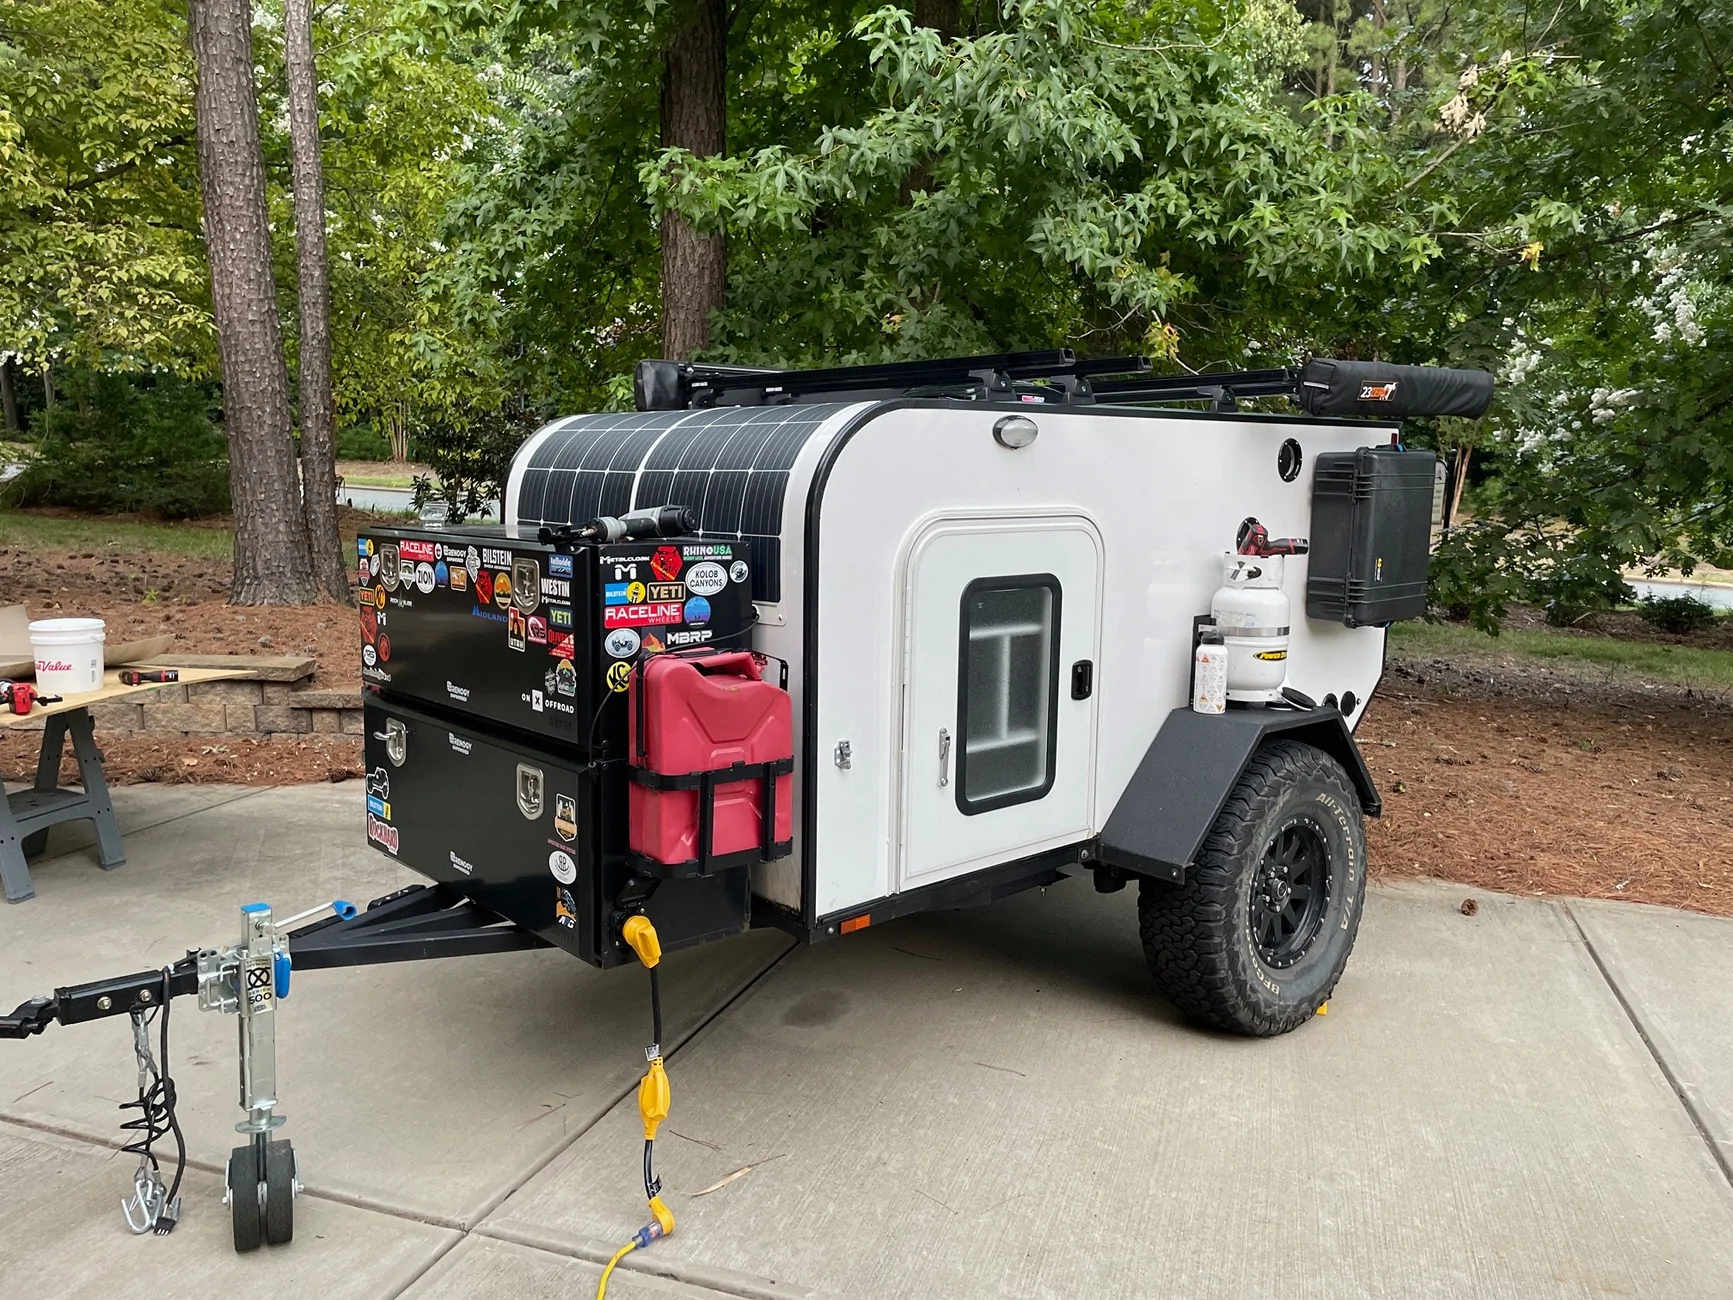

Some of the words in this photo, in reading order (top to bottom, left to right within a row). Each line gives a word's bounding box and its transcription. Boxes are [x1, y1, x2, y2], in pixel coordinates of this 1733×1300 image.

[400, 541, 433, 554] RACELINE
[683, 545, 732, 556] RHINOUSA
[483, 548, 512, 566] BILSTEIN
[418, 570, 433, 585] ZION
[696, 570, 718, 579] KOLOB
[541, 578, 570, 597] WESTIN
[690, 579, 723, 588] CANYONS
[650, 586, 682, 598] YETI
[551, 609, 571, 625] YETI
[605, 604, 680, 620] RACELINE
[648, 615, 680, 623] WHEELS
[510, 637, 524, 649] UTAH
[667, 631, 713, 645] MBRP
[1259, 652, 1281, 660] POWER
[38, 660, 72, 672] Value
[545, 699, 575, 714] OFFROAD
[1315, 792, 1354, 882] All-Terrain
[1340, 895, 1354, 930] T/A
[249, 992, 272, 1004] 500
